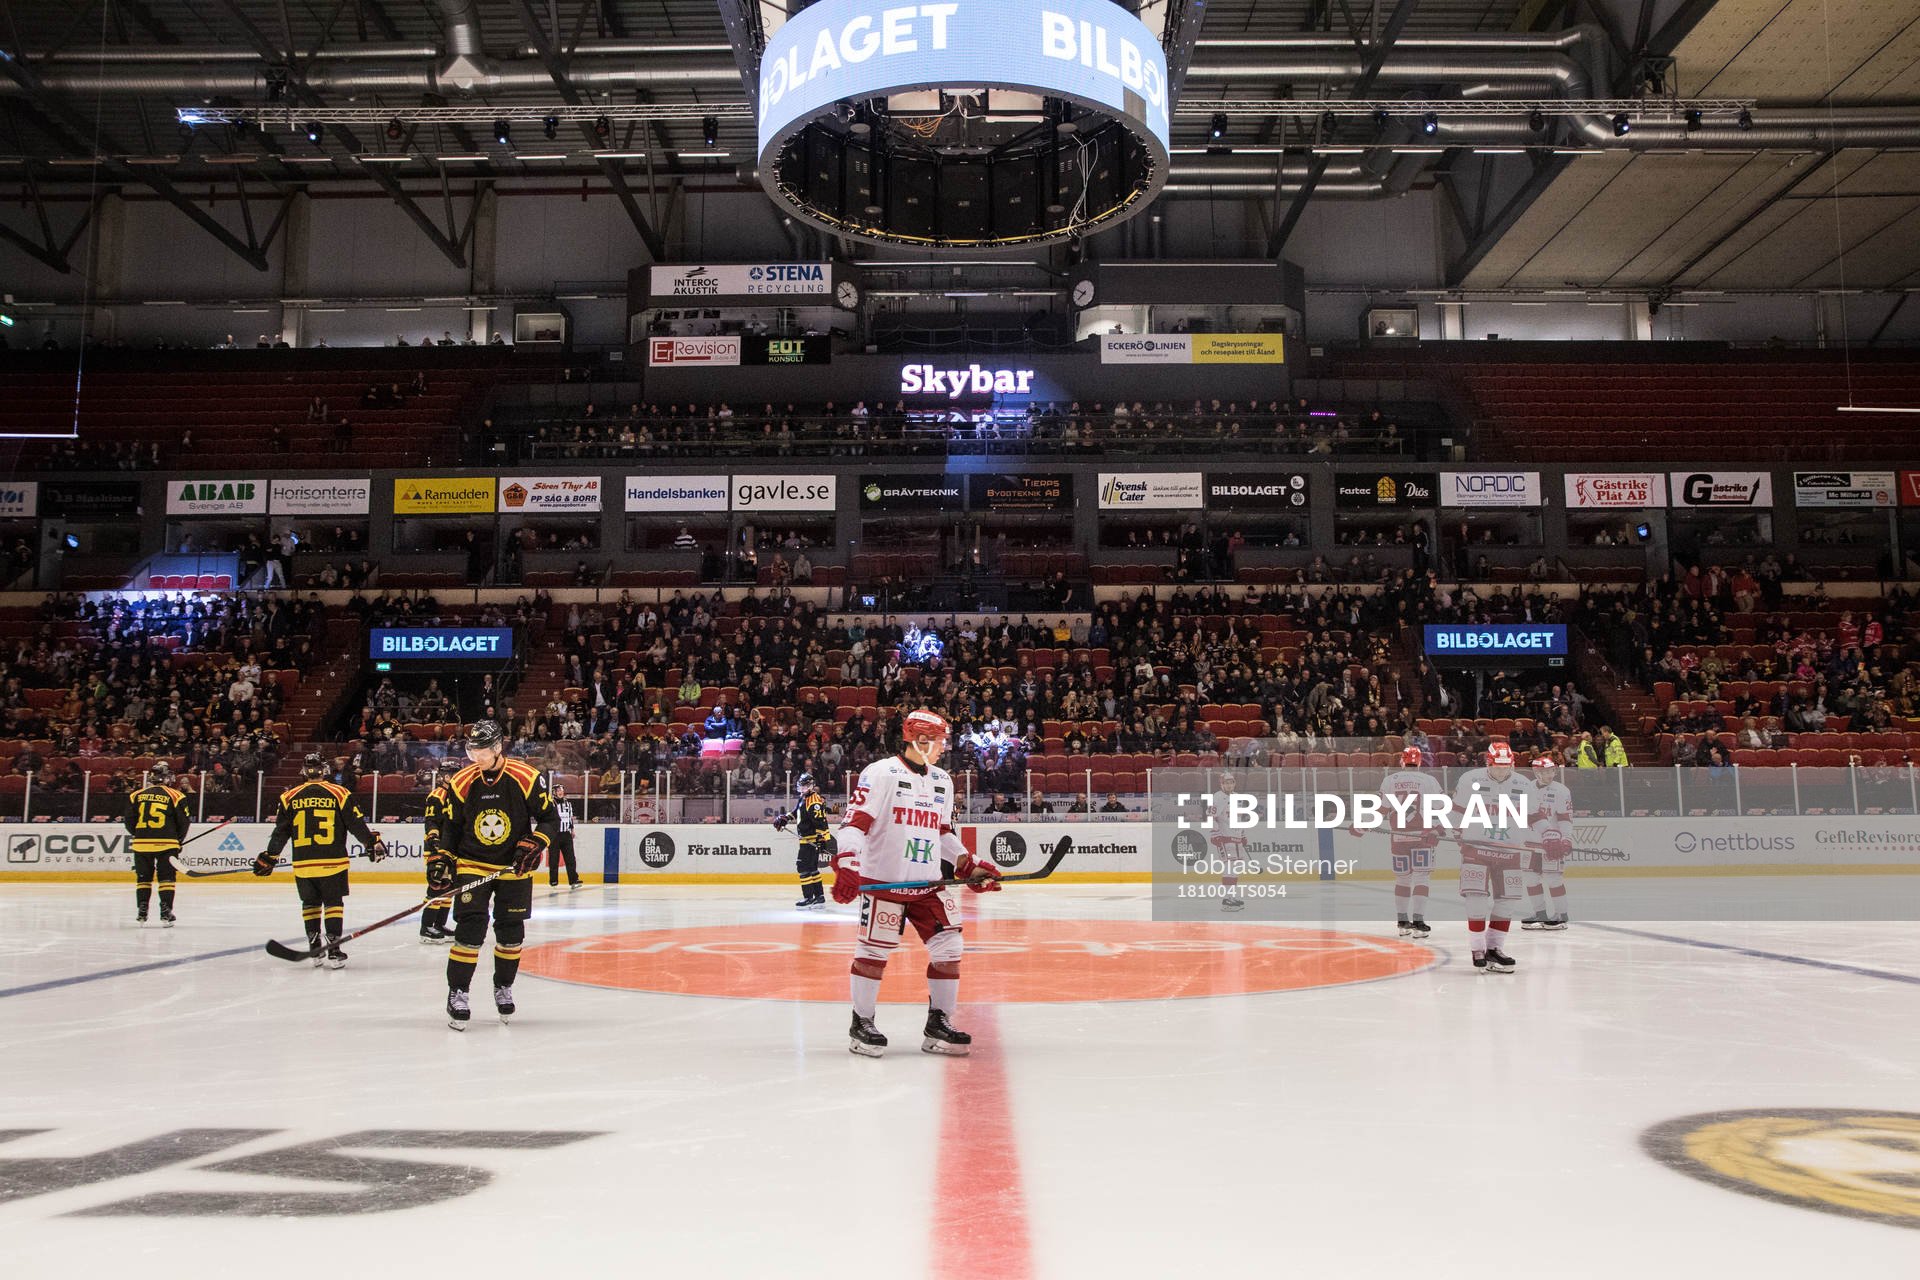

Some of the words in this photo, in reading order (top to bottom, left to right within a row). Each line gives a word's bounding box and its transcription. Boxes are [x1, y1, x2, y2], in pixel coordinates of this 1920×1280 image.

[766, 265, 824, 281] STENA
[674, 278, 719, 287] INTEROC
[673, 286, 719, 295] AKUSTIK
[748, 284, 824, 293] RECYCLING
[675, 341, 737, 355] Revision
[768, 340, 805, 354] EOT
[1107, 340, 1143, 350] ECKERÖ
[1155, 342, 1186, 350] LINJEN
[1211, 340, 1264, 350] Dagskryssningar
[1200, 348, 1212, 356] och
[1213, 348, 1245, 357] resepaket
[1245, 347, 1256, 356] till
[1256, 346, 1275, 356] Åland
[768, 355, 804, 363] KONSULT
[901, 364, 1035, 400] Skybar
[532, 482, 559, 490] Sören
[562, 481, 584, 491] Thyr
[584, 481, 598, 489] AB
[1114, 481, 1147, 491] Svensk
[1404, 482, 1429, 497] Diös
[1456, 475, 1526, 493] NORDIC
[1592, 479, 1648, 490] Gästrike
[179, 483, 256, 501] ABAB
[273, 486, 367, 500] Horisonterra
[424, 488, 489, 501] Ramudden
[628, 488, 726, 499] Handelsbanken
[738, 480, 829, 505] gavle.se
[883, 488, 959, 497] GRÄVTEKNIK
[1211, 485, 1287, 496] BILBOLAGET
[1339, 487, 1371, 495] Fastec
[1597, 490, 1624, 501] Plåt
[1627, 491, 1647, 501] AB
[531, 495, 542, 503] PP
[543, 493, 562, 503] SÅG
[573, 494, 597, 503] BORR
[1119, 491, 1146, 502] Cater
[189, 502, 225, 511] Sverige
[228, 502, 244, 510] AB
[382, 635, 501, 652] BILBOLAGET
[1436, 632, 1555, 649] BILBOLAGET
[292, 797, 337, 810] GUNDERSON
[136, 802, 168, 829] 15
[893, 806, 941, 831] TIMR
[293, 808, 336, 849] 13
[645, 837, 656, 845] EN
[996, 837, 1007, 845] EN
[1177, 835, 1187, 844] EN
[1701, 832, 1795, 851] nettbuss
[645, 845, 661, 854] BRA
[687, 844, 711, 856] För
[711, 844, 738, 856] alla
[739, 844, 772, 856] barn
[996, 845, 1012, 853] BRA
[1039, 843, 1055, 854] Vi
[1078, 843, 1138, 854] matchen
[1271, 842, 1304, 853] barn
[45, 855, 116, 863] SVENSKA
[645, 854, 669, 862] START
[818, 854, 832, 862] ART
[996, 853, 1020, 861] START
